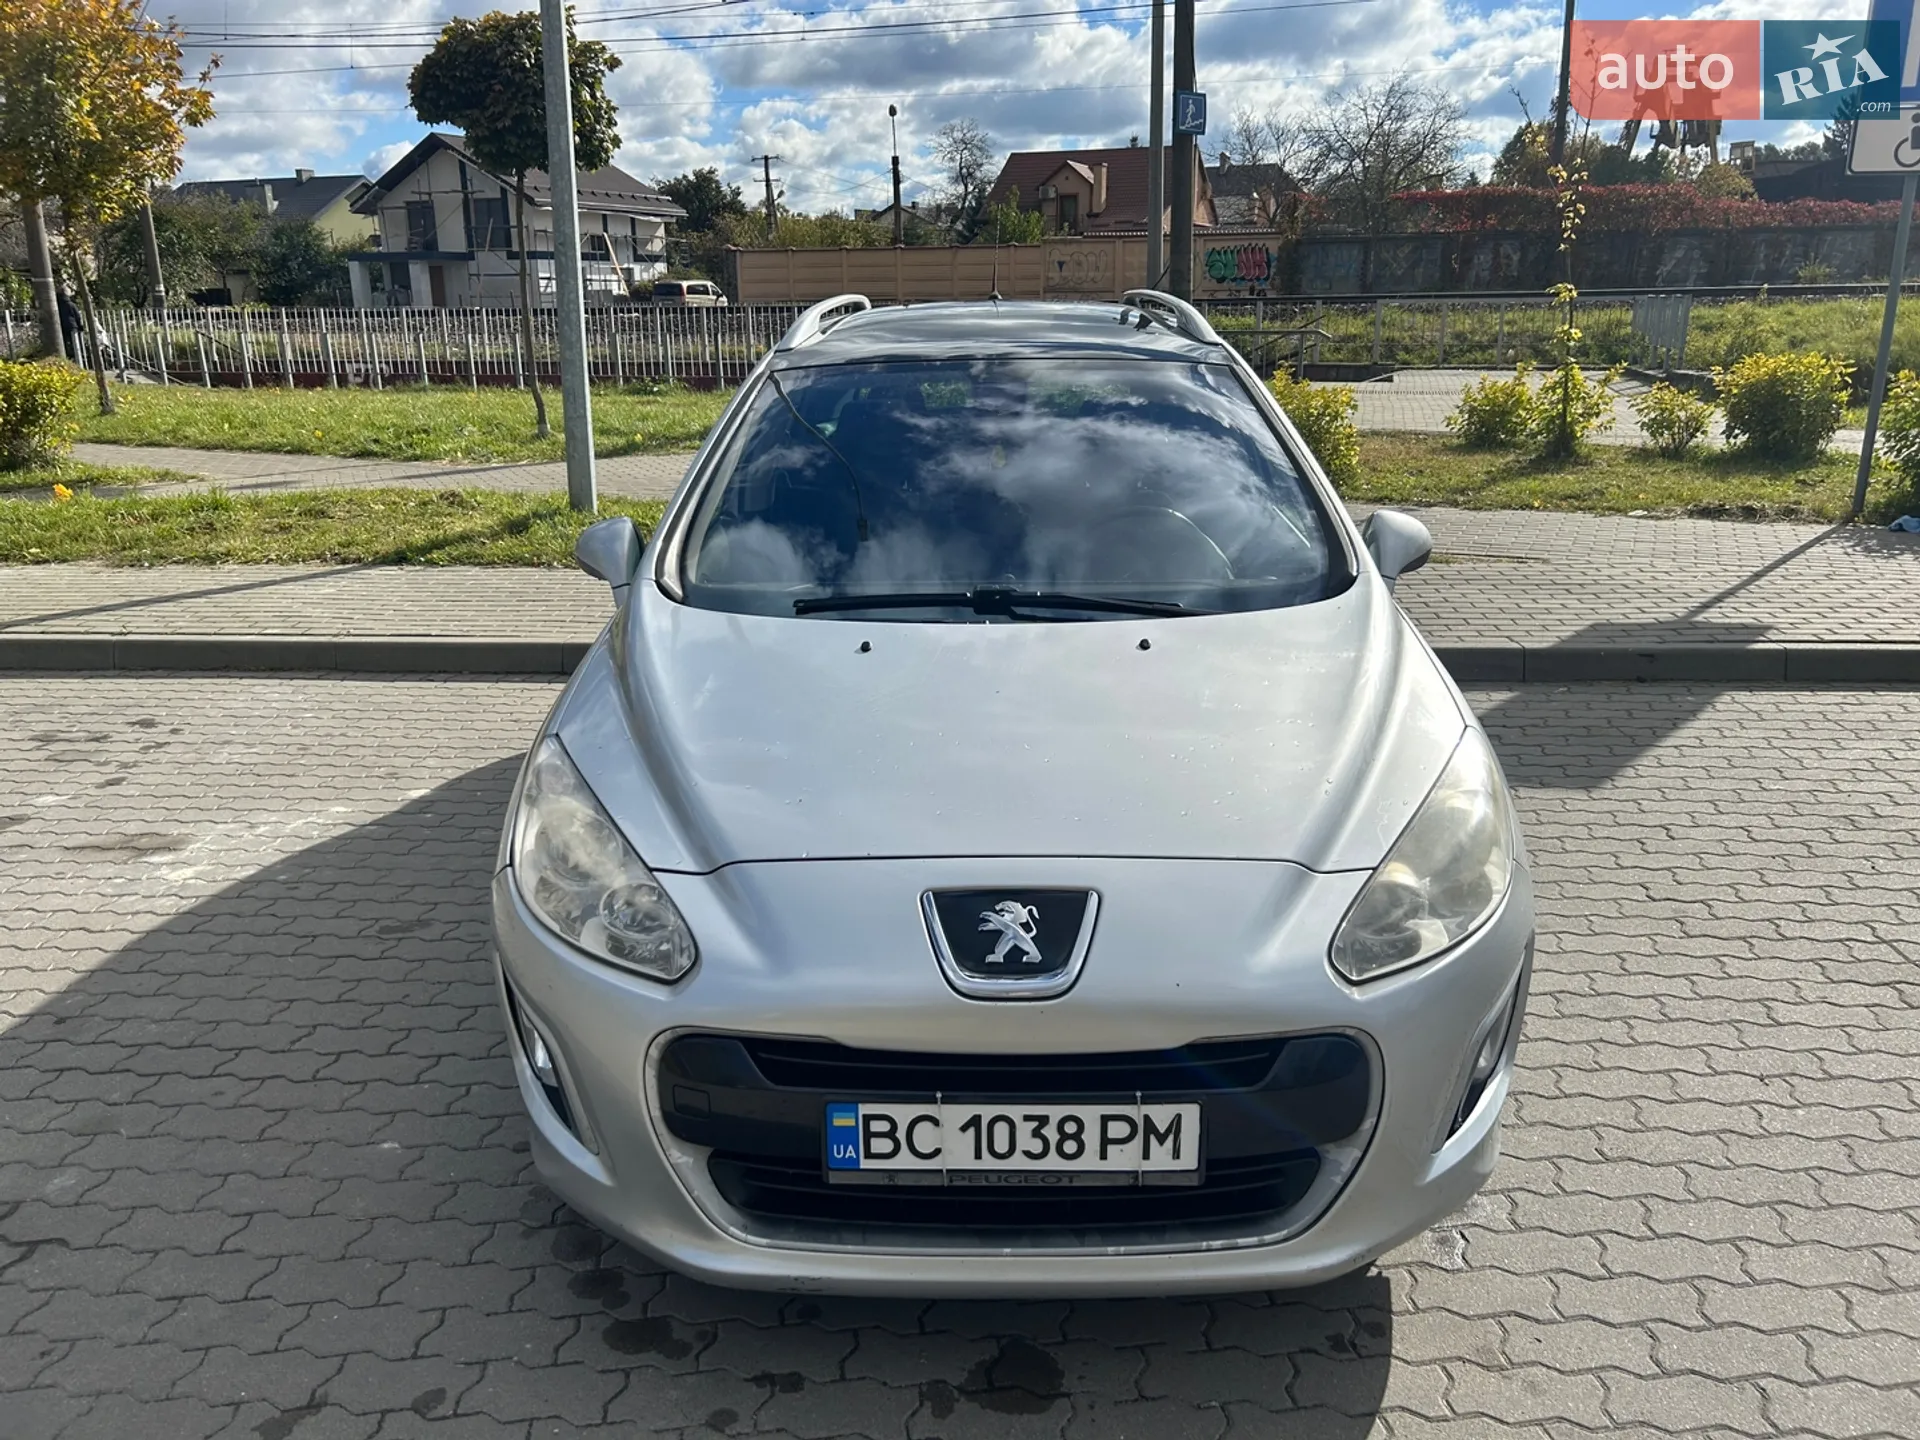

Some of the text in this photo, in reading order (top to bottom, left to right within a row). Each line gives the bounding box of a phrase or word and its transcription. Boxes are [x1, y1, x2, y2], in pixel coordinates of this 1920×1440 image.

[861, 1113, 1182, 1161] BC 1038 PM
[833, 1144, 857, 1159] UA
[949, 1174, 1081, 1185] PEUGEOT
